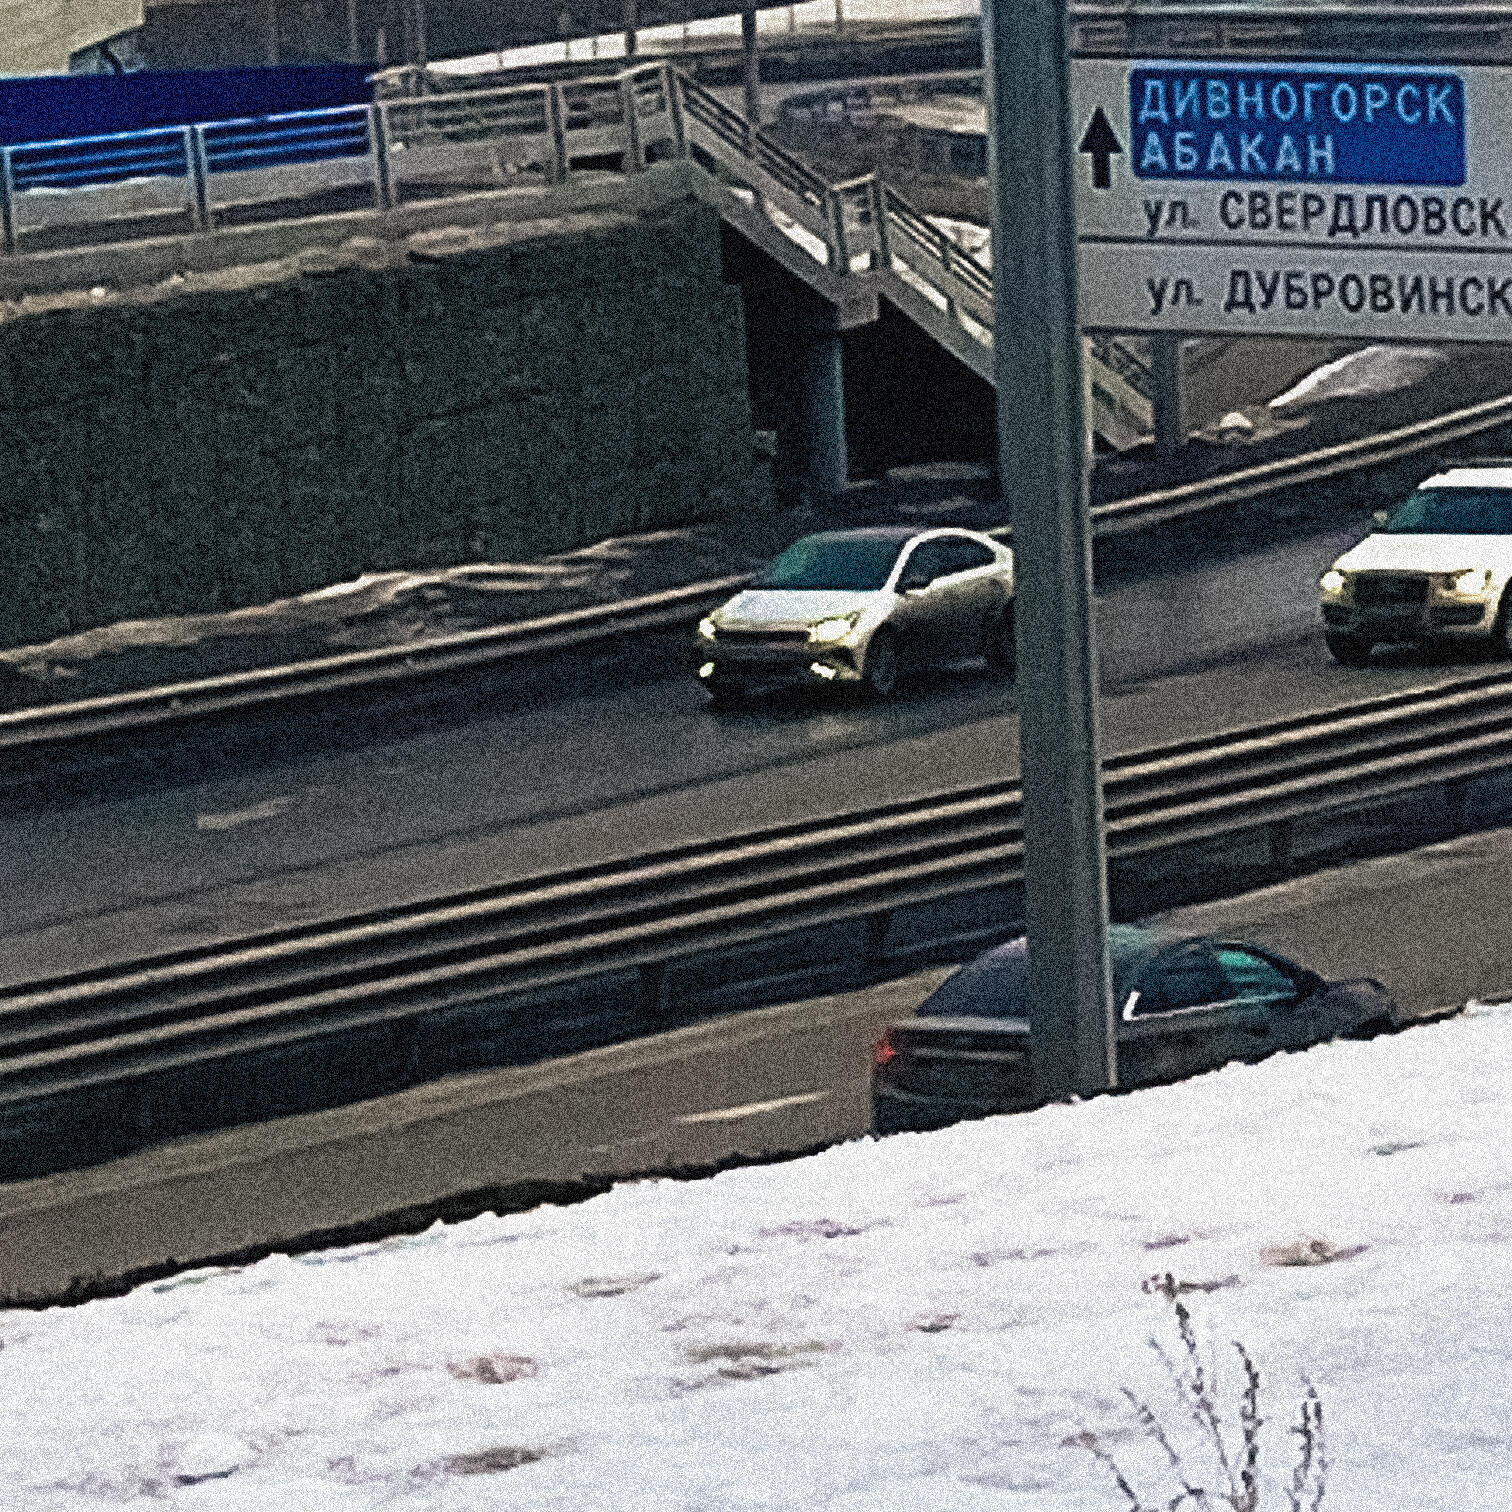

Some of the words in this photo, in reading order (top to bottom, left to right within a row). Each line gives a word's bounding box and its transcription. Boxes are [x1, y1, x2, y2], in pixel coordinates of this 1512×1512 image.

[1137, 78, 1455, 124] ДИВНОГОРСК
[1140, 132, 1335, 175] АБАКАН
[1143, 197, 1197, 236] ул.
[1147, 276, 1202, 316] ул.
